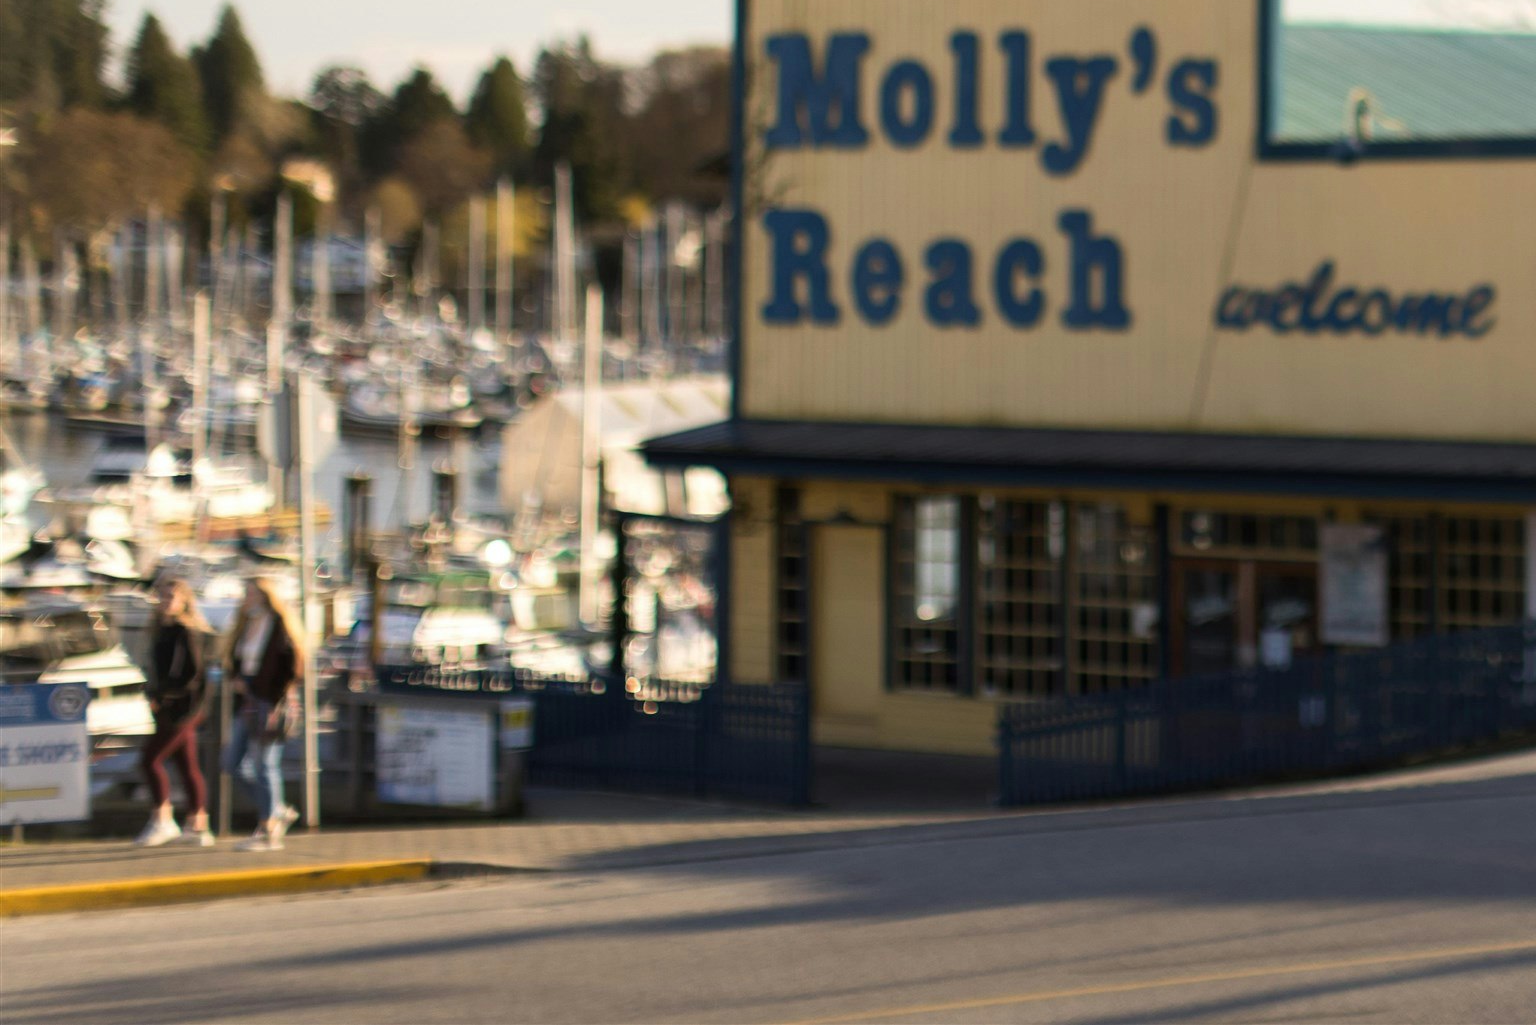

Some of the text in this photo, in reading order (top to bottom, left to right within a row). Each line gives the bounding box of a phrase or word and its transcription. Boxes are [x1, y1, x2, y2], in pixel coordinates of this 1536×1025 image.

[763, 23, 1219, 177] Molly's
[760, 206, 1133, 331] Reach
[1214, 258, 1497, 340] welcome
